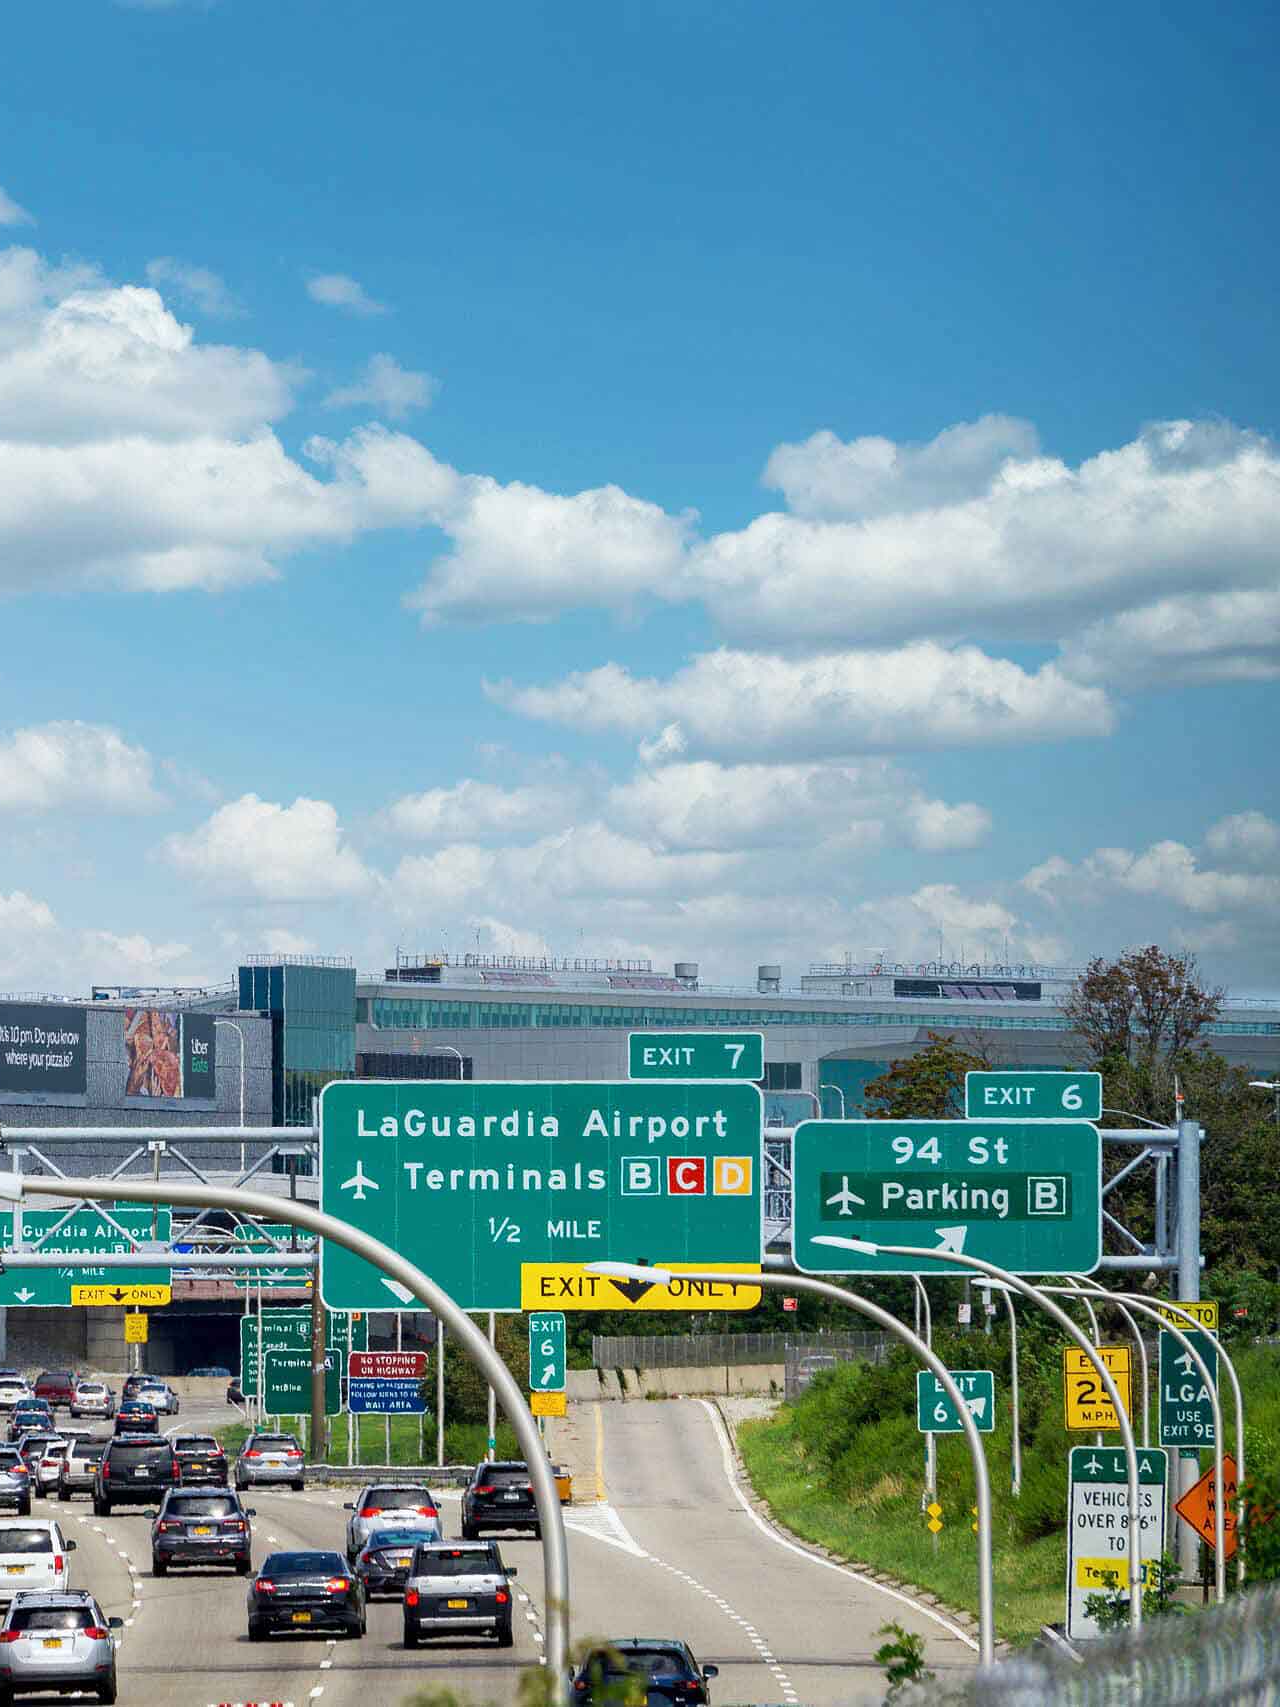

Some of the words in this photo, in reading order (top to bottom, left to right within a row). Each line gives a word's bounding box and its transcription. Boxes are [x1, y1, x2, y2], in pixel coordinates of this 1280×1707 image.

[11, 1026, 19, 1043] 10
[34, 1027, 46, 1044] Do
[46, 1031, 60, 1048] you
[60, 1028, 80, 1045] know
[191, 1039, 209, 1055] Uber
[5, 1048, 28, 1065] where
[28, 1052, 45, 1070] your
[45, 1051, 63, 1071] pizza
[643, 1047, 695, 1066] EXIT
[724, 1044, 745, 1069] 7
[984, 1087, 1035, 1105] EXIT
[1061, 1084, 1083, 1110] 6
[357, 1109, 560, 1138] LaGuardia
[582, 1109, 728, 1143] Airport
[891, 1136, 942, 1164] 94
[967, 1136, 1009, 1164] St
[404, 1162, 606, 1191] Terminals
[629, 1163, 652, 1190] B
[673, 1162, 698, 1191] C
[721, 1163, 745, 1190] D
[882, 1182, 1009, 1218] Parking
[1035, 1183, 1057, 1209] B
[3, 1225, 87, 1238] LGurdia
[547, 1220, 601, 1239] MILE
[82, 1267, 105, 1277] MILE
[80, 1289, 105, 1300] EXIT
[132, 1289, 163, 1300] ONLY
[540, 1277, 601, 1297] EXIT
[1196, 1309, 1213, 1322] TO
[248, 1324, 293, 1332] Teminal
[531, 1320, 563, 1332] EXIT
[541, 1338, 555, 1356] 6
[272, 1359, 312, 1368] Termina
[360, 1356, 373, 1365] NO
[376, 1356, 417, 1365] STOPPING
[1079, 1354, 1115, 1368] EIT
[361, 1367, 373, 1375] ON
[377, 1367, 416, 1375] HIGHWAY
[935, 1377, 977, 1392] EIT
[1165, 1384, 1212, 1402] LGA
[933, 1401, 948, 1423] 6
[1177, 1410, 1201, 1423] USE
[1163, 1425, 1189, 1437] EXIT
[1193, 1424, 1215, 1438] 9E
[1113, 1457, 1152, 1474] LA
[1083, 1491, 1152, 1508] VEHICS
[1078, 1513, 1115, 1529] OVER
[1108, 1536, 1125, 1552] TO
